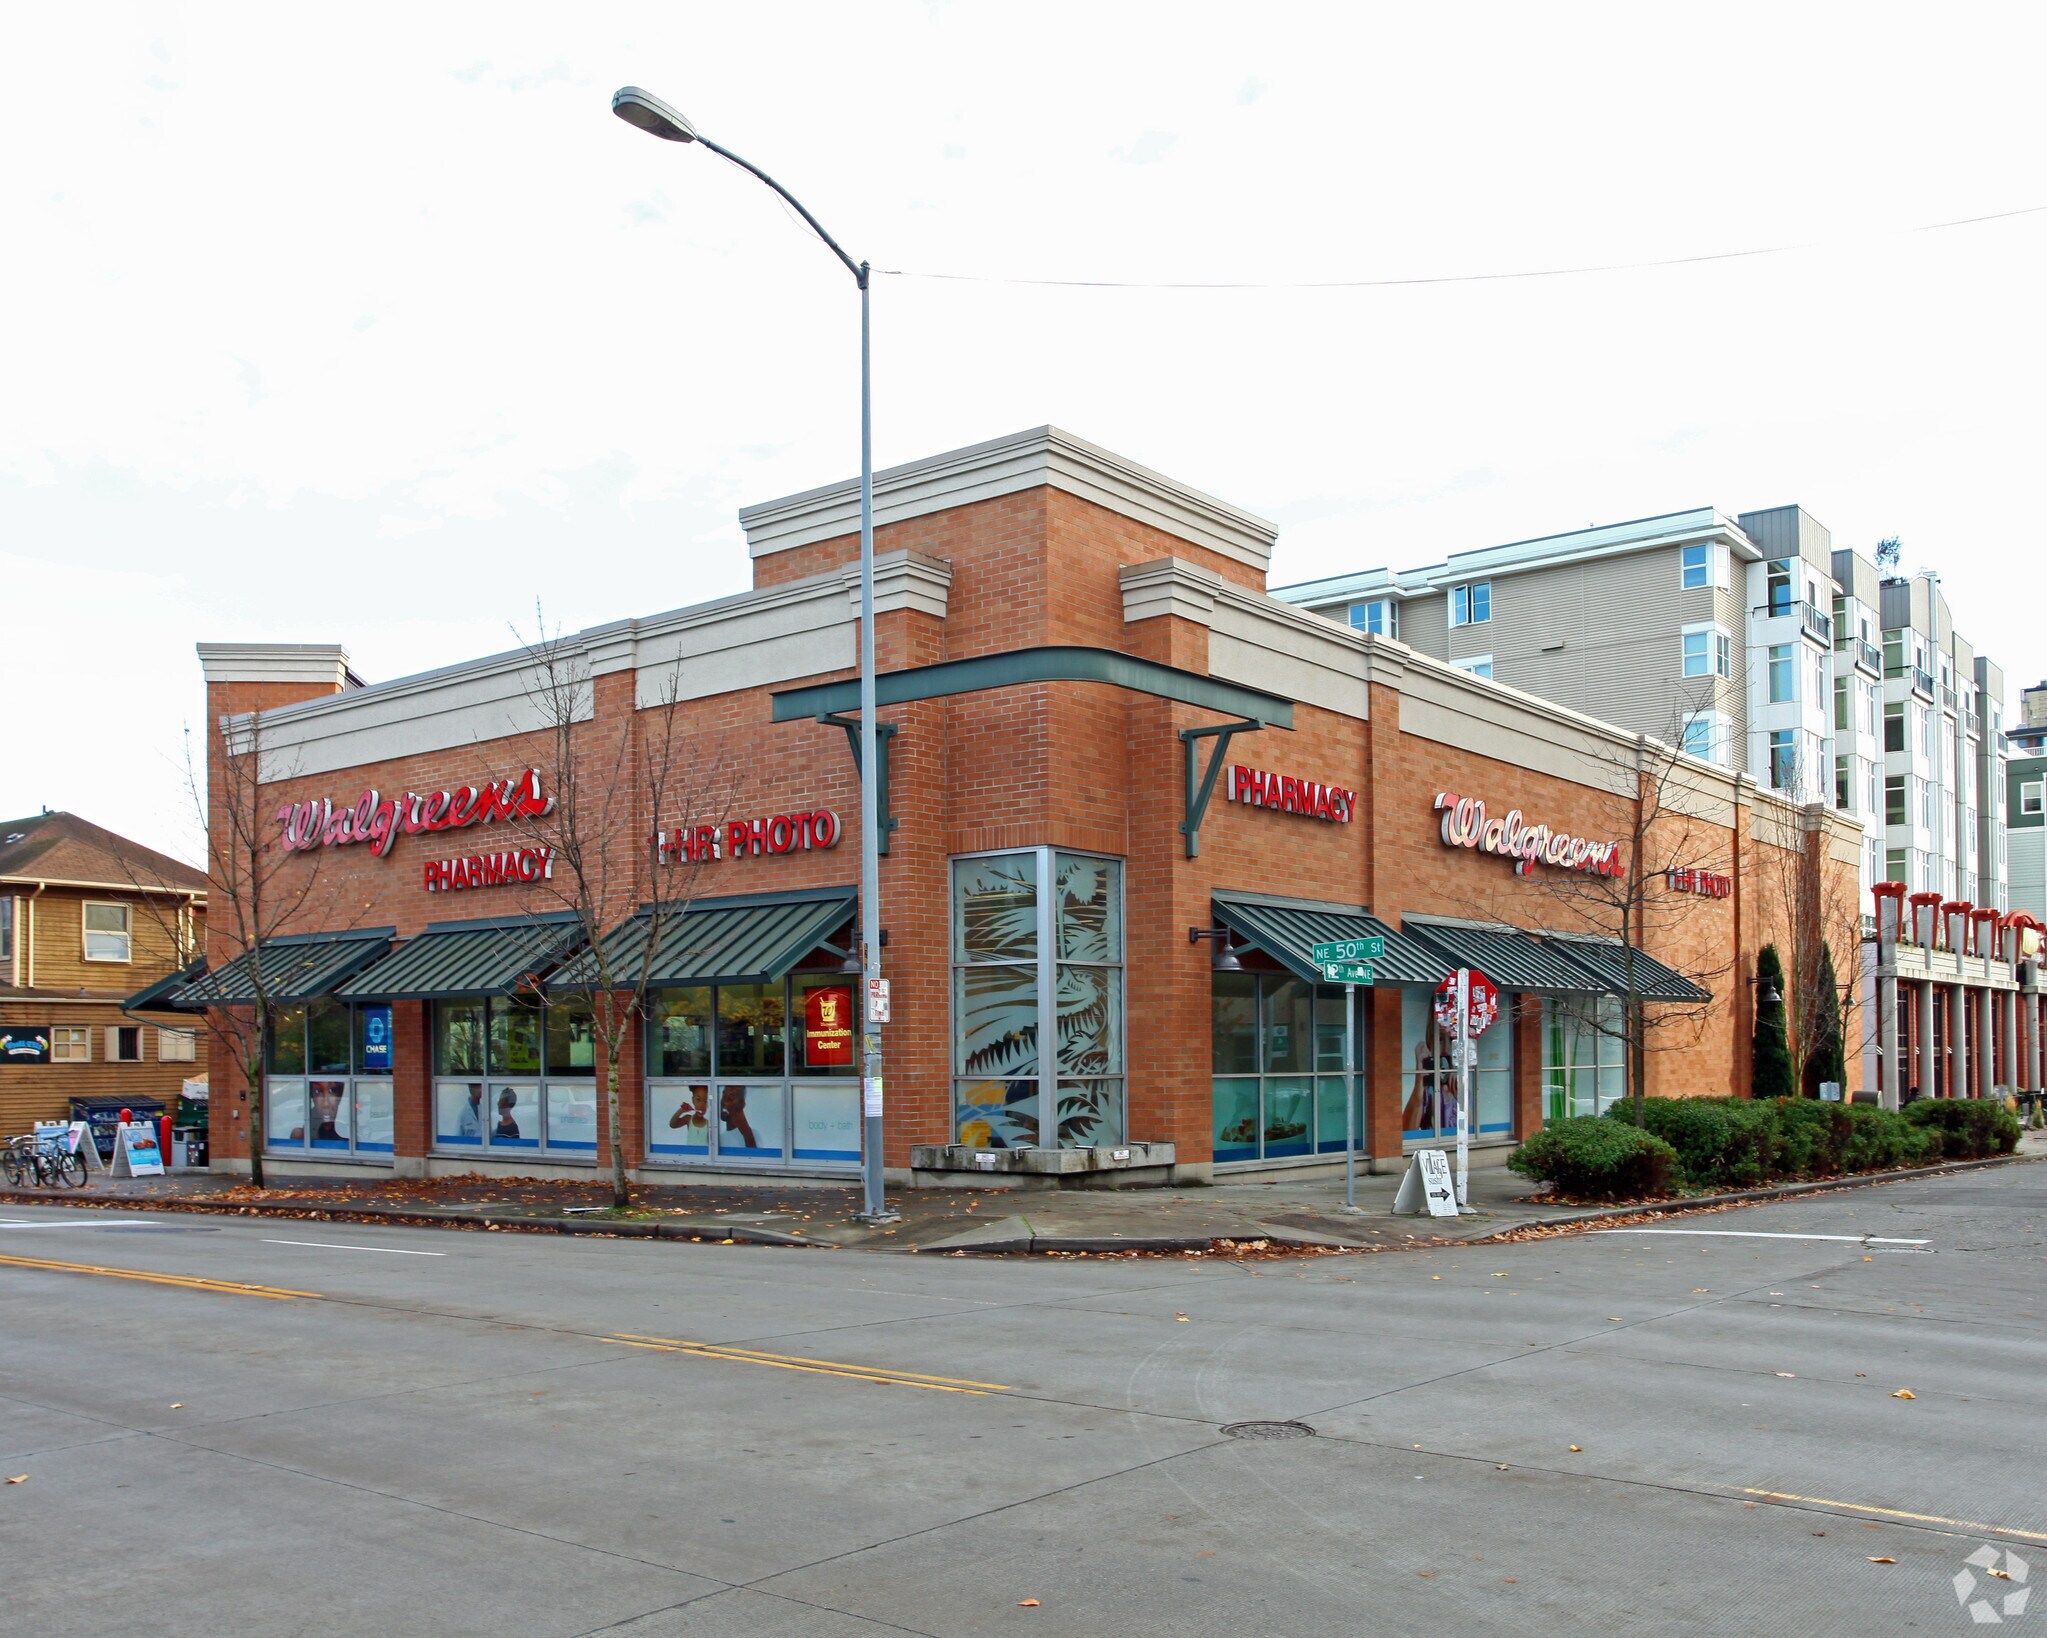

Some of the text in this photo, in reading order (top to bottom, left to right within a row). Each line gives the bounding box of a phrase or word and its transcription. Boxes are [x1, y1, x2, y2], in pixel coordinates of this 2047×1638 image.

[1228, 765, 1357, 823] PHARMACY
[276, 768, 553, 857] Walgreens
[728, 810, 841, 858] PHOTO
[1434, 793, 1625, 878] Walgreens
[424, 846, 557, 892] PHARMACY
[1316, 942, 1381, 959] NE 50th St
[806, 1028, 852, 1038] Immunization
[818, 1041, 841, 1049] Center
[366, 1045, 387, 1053] CHASE
[808, 1120, 827, 1131] body
